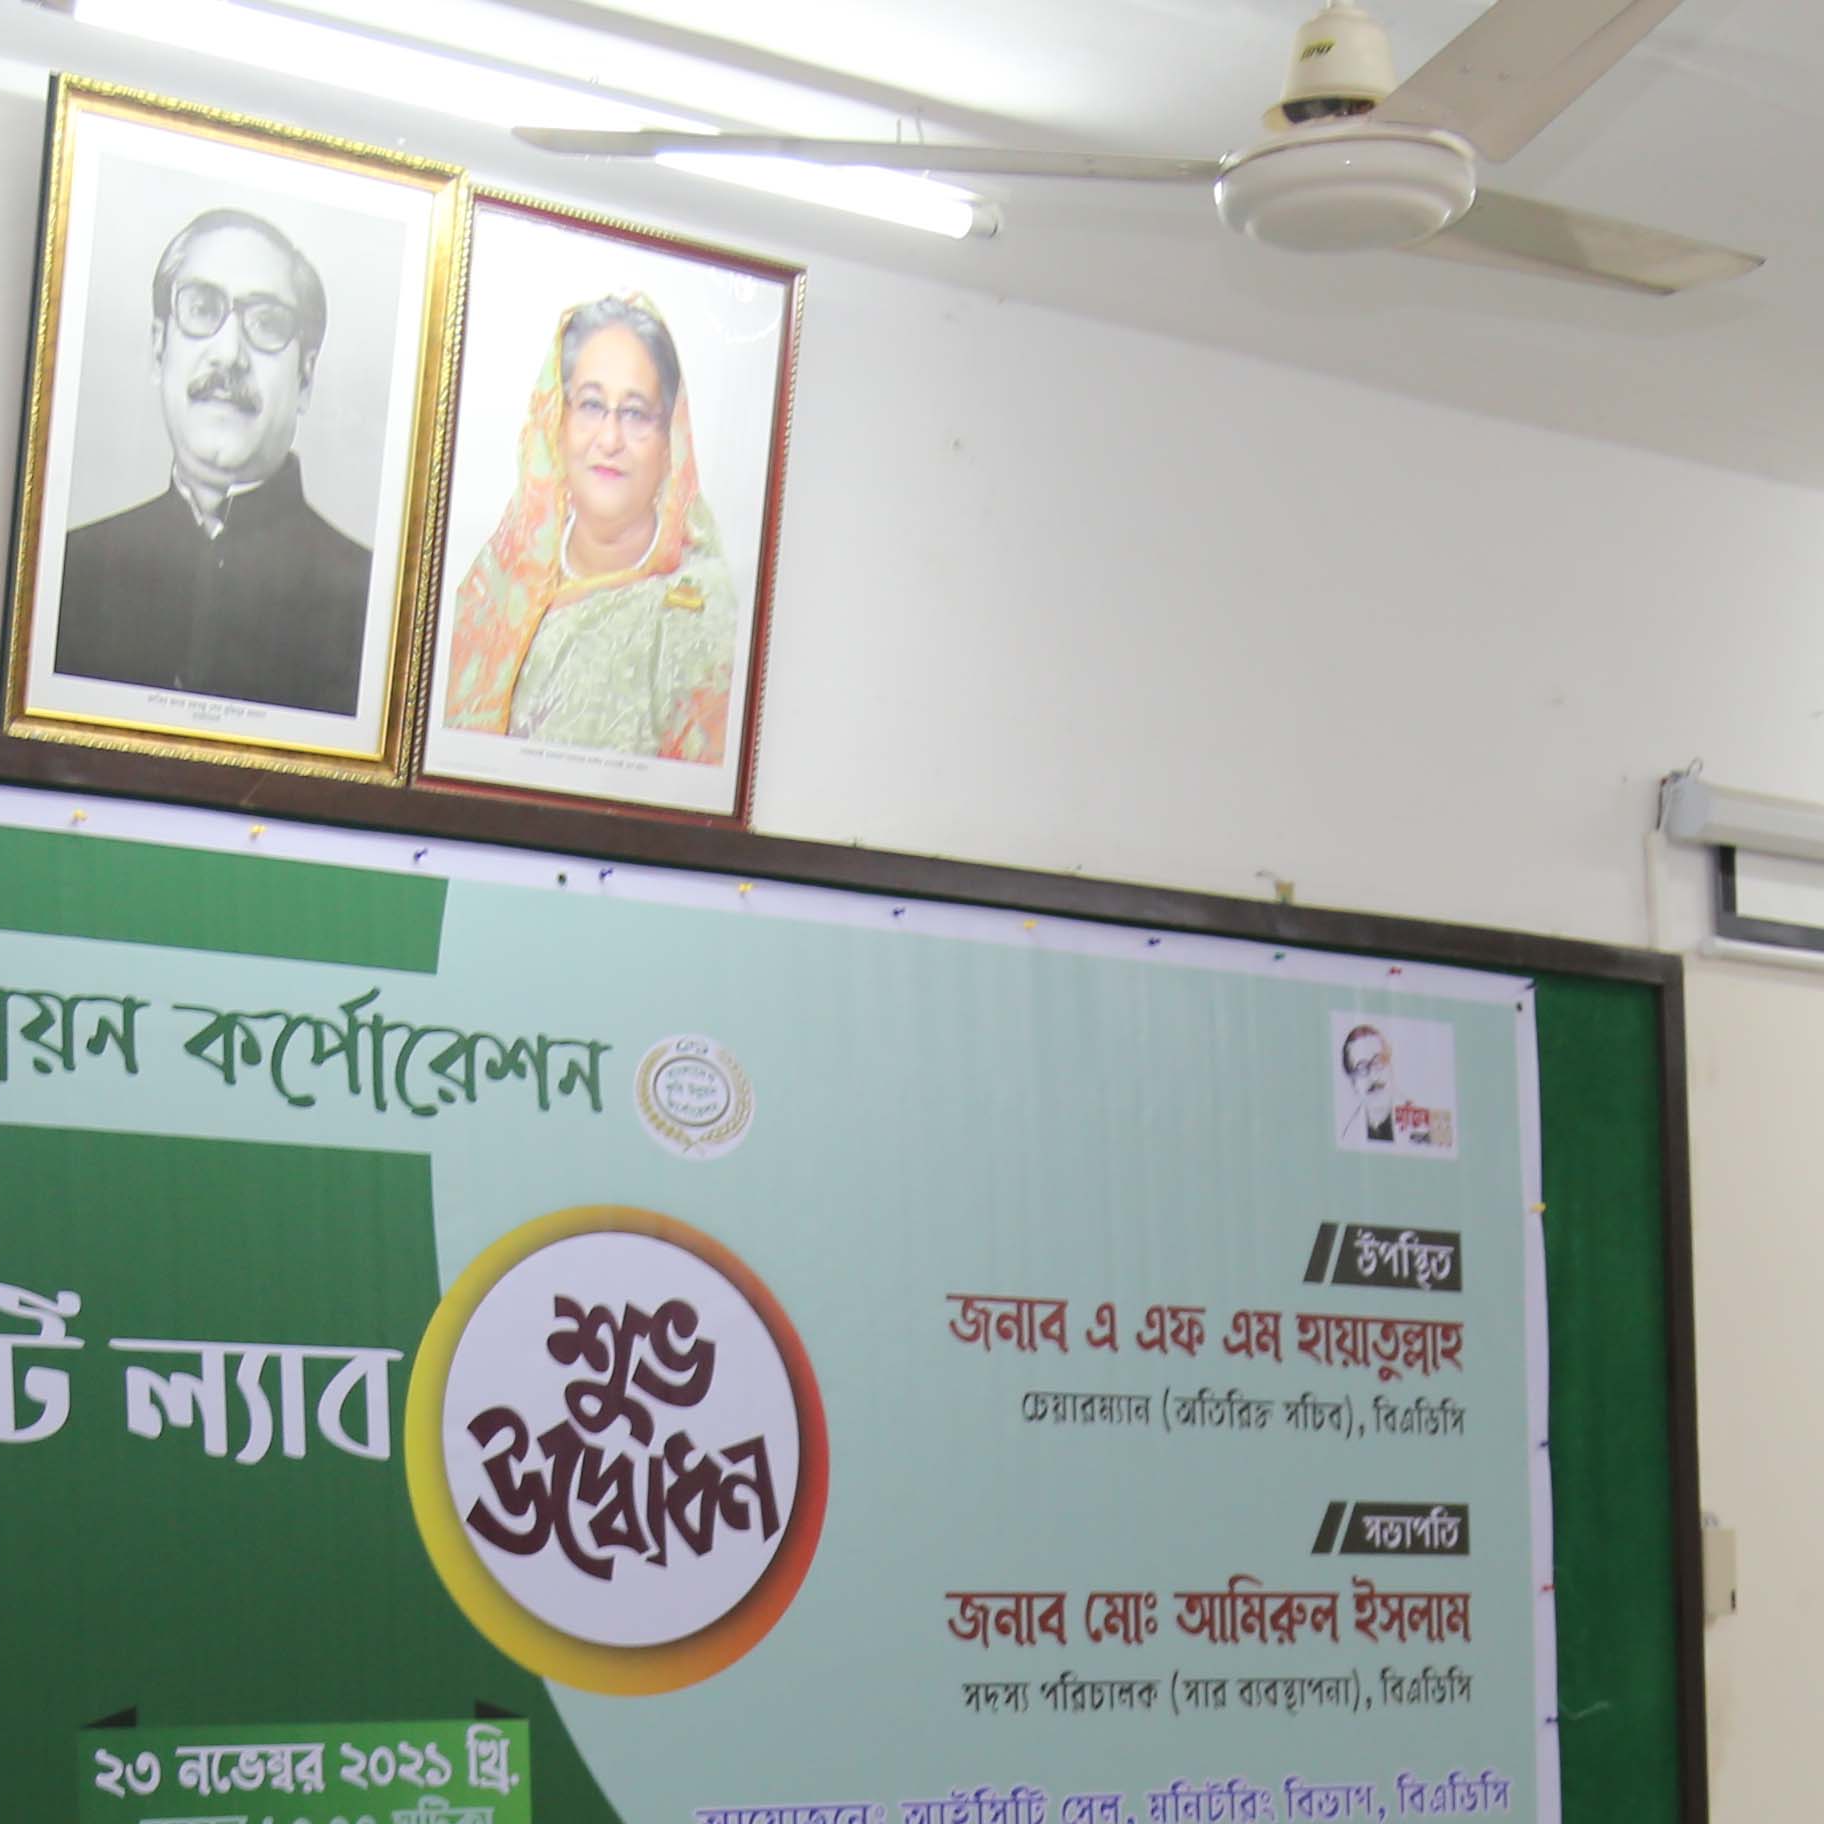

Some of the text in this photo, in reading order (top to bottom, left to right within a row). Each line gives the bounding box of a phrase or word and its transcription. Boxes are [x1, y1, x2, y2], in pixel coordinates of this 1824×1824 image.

[172, 987, 613, 1117] কর্পোরেশন
[1355, 1228, 1456, 1292] উপস্থিত
[546, 1294, 717, 1448] শুভ
[945, 1292, 1464, 1382] জনাব এ এফ এম হায়াতুল্লাহ
[108, 1337, 404, 1465] ল্যাব
[1022, 1390, 1151, 1427] চেয়ারম্যান
[1161, 1386, 1274, 1435] (অতিরিক্ত
[1373, 1393, 1466, 1437] বিএডিসি
[466, 1405, 781, 1582] উদ্বোধন
[1361, 1505, 1462, 1551] সভাপতি
[945, 1572, 1472, 1649] জনাব মোঃ আমিরুল ইসলাম
[962, 1681, 1031, 1713] সদস্য
[1040, 1670, 1161, 1714] পরিচালক
[1171, 1668, 1228, 1716] (সার
[1380, 1667, 1474, 1709] বিএডিসি
[94, 1723, 521, 1799] ২৩ নভেম্বর ২০২১ খ্রি.
[1284, 1774, 1386, 1824] বিভাগ,
[1396, 1770, 1511, 1815] বিএডিসি
